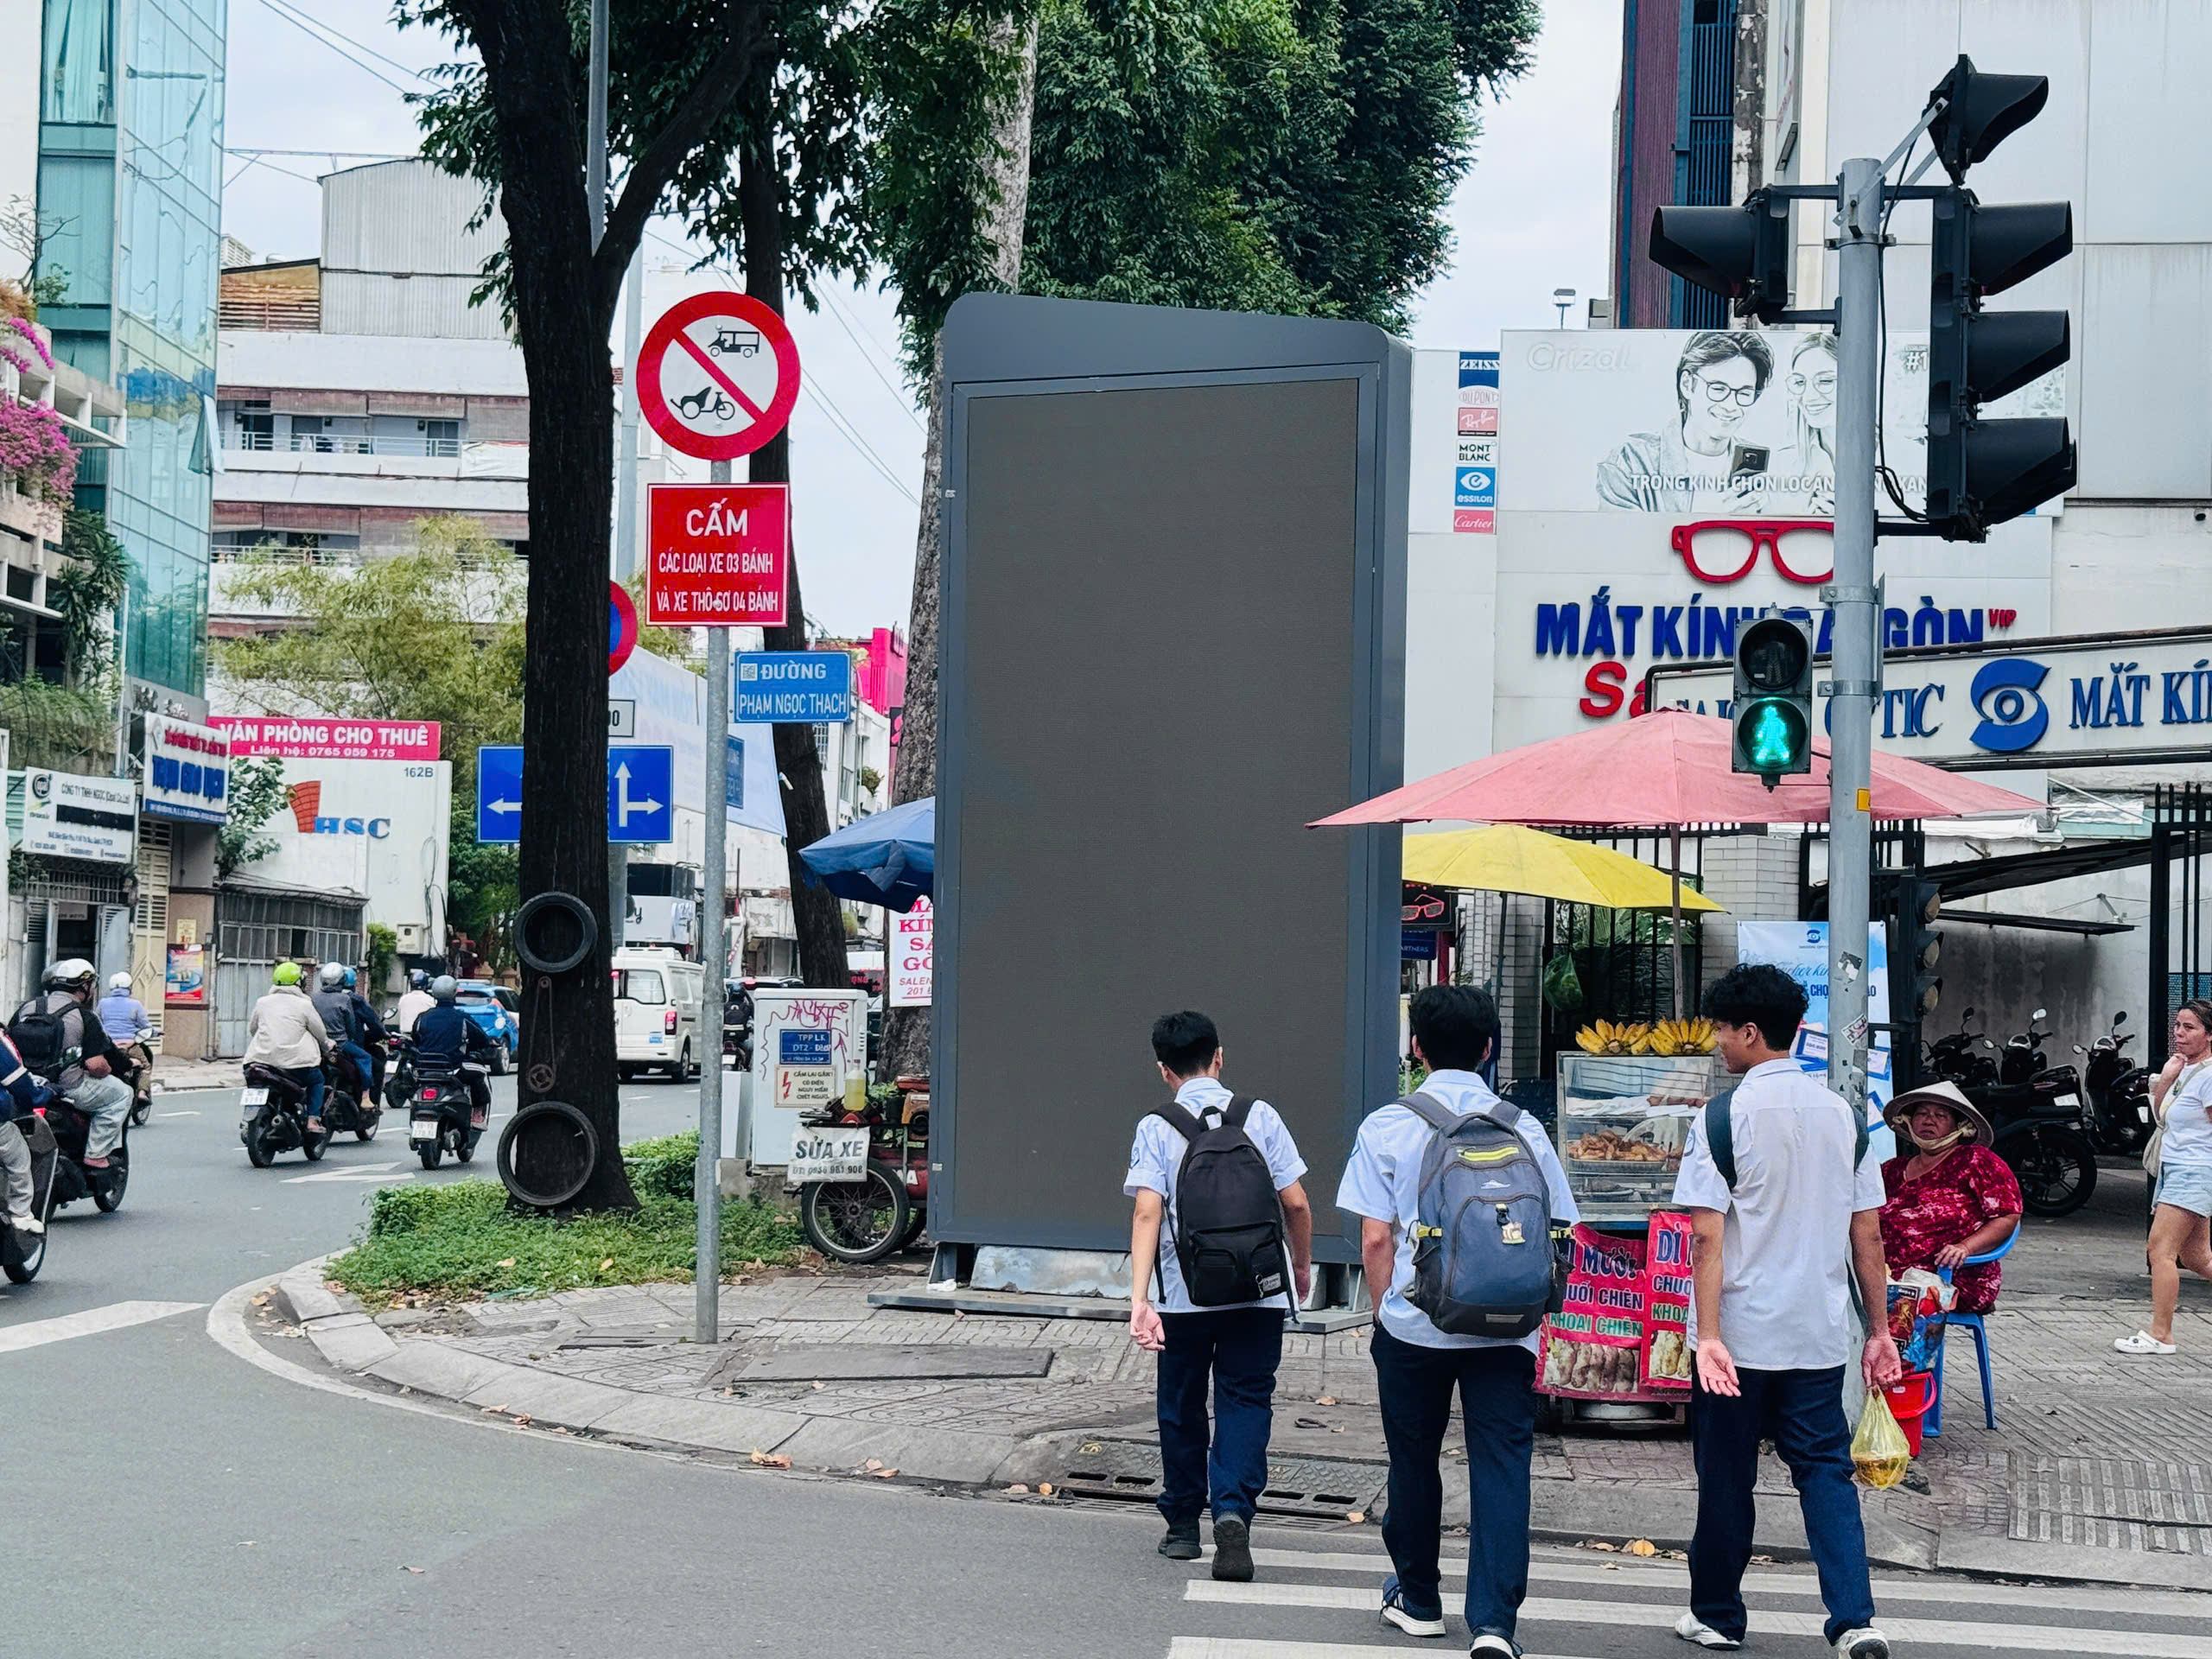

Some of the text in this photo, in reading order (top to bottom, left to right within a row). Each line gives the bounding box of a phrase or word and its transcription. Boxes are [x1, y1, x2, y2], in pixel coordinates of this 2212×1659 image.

[1459, 359, 1500, 371] ZEISS
[1527, 341, 1631, 372] Crizal
[1458, 454, 1491, 462] BLANC
[1459, 444, 1491, 453] MONT
[1457, 495, 1493, 504] essilor
[685, 498, 748, 537] CẤM
[658, 548, 773, 577] CÁC LOẠI XE 03 BÁNH
[656, 586, 671, 612] VÀ
[673, 591, 688, 612] XE
[733, 592, 746, 612] 04
[748, 586, 778, 612] BÁNH
[1536, 586, 1643, 657] MẮT
[1652, 593, 1769, 658] KÍN
[1989, 609, 2017, 629] VIP
[760, 659, 827, 680] ĐƯỜNG
[2069, 658, 2212, 729] MẮT KÍ
[739, 693, 847, 720] PHẠM NGỌC THẠCH
[219, 720, 429, 747] VĂN PHÒNG CHO THUÊ
[251, 746, 280, 755] Liên
[308, 747, 340, 756] 0765
[343, 747, 368, 757] 059
[372, 748, 396, 758] 175
[404, 767, 434, 778] 162B
[315, 817, 391, 839] HSC
[795, 1135, 864, 1160] SỬA XE
[1655, 1221, 1682, 1266] DÌ
[1598, 1287, 1644, 1311] CHIÊN
[1549, 1313, 1592, 1333] KHOAI
[1651, 1302, 1689, 1324] KHOA
